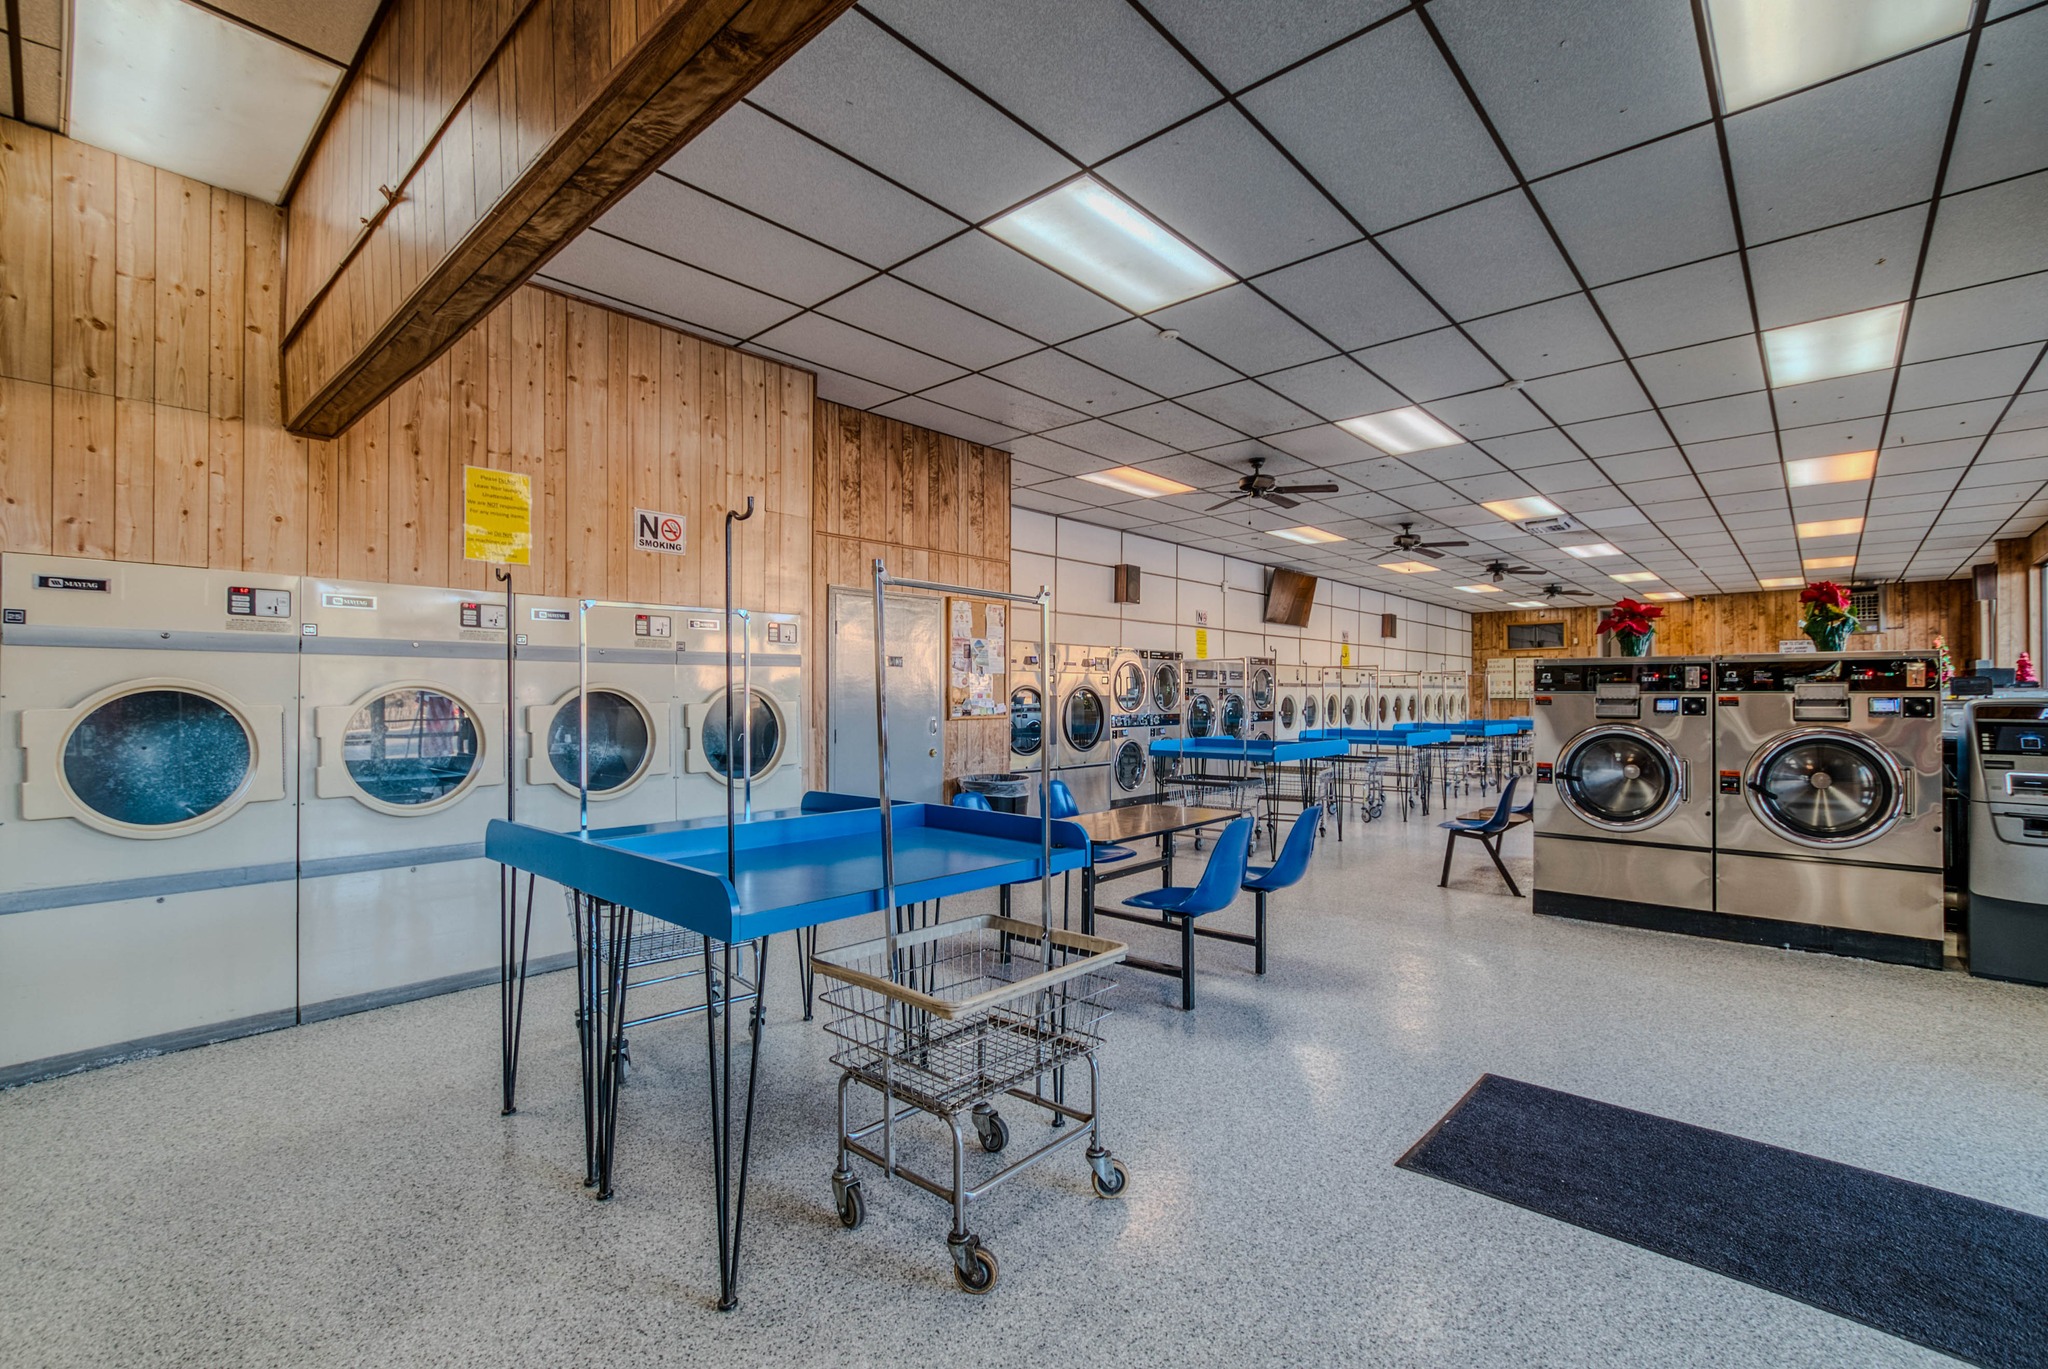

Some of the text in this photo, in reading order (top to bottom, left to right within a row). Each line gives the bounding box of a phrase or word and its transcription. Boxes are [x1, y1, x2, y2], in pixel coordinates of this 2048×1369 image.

[490, 511, 510, 519] missing
[639, 539, 682, 551] SMOKING
[64, 581, 98, 589] MAYTAG
